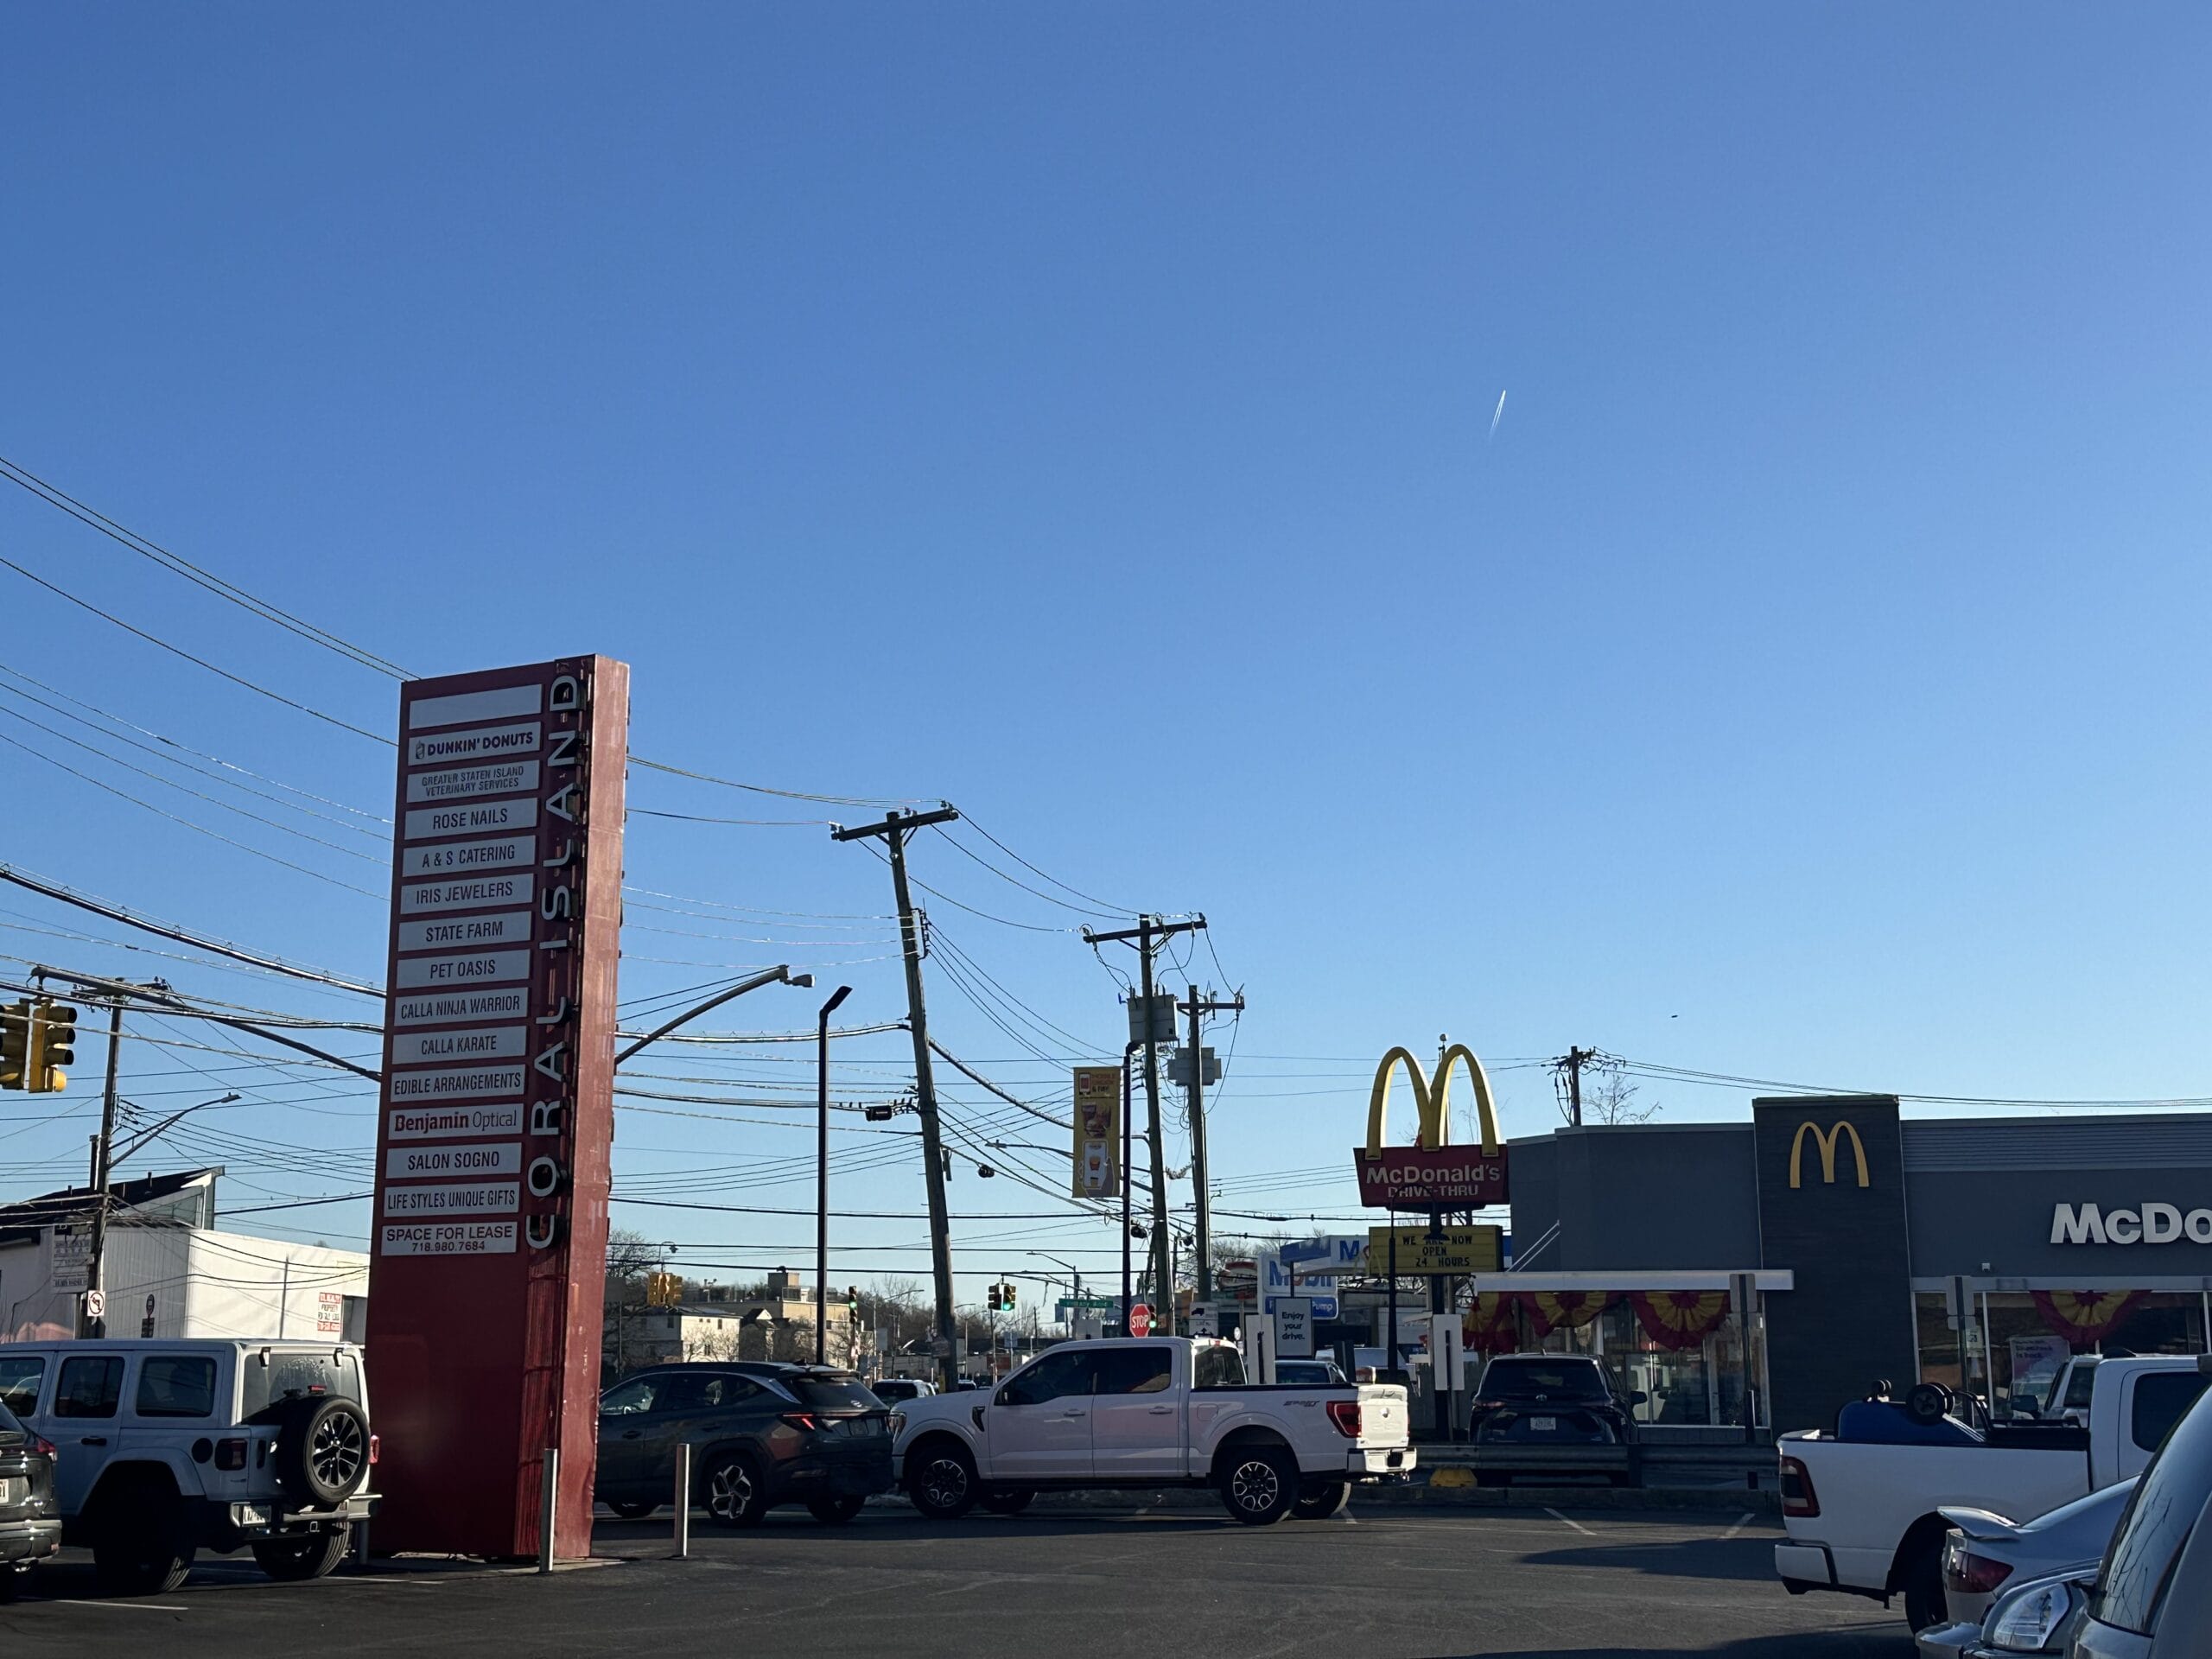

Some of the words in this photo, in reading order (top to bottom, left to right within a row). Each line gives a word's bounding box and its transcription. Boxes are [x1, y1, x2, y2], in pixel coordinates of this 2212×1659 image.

[427, 738, 480, 756] DUNKIN'
[482, 732, 533, 749] DONUTS
[422, 773, 459, 786] GREATER
[461, 768, 491, 782] STATEN
[493, 766, 524, 778] ISLAND
[426, 782, 476, 796] VETERINARY
[478, 778, 518, 791] SERVICES
[433, 813, 467, 830] ROSE
[471, 809, 508, 826] NAILS
[539, 674, 579, 950] ISLAND
[422, 853, 429, 868] A
[434, 851, 442, 866] &
[446, 850, 453, 865] S
[459, 844, 515, 864] CATERING
[416, 889, 441, 905] IRIS
[445, 881, 513, 902] JEWELERS
[426, 924, 463, 942] STATE
[467, 921, 503, 938] FARM
[429, 963, 452, 979] PET
[457, 960, 495, 976] OASIS
[401, 1002, 433, 1019] CALLA
[436, 999, 467, 1016] NINJA
[470, 995, 520, 1014] WARRIOR
[421, 1039, 454, 1055] CALLA
[457, 1035, 497, 1052] KARATE
[394, 1077, 430, 1095] EDIBLE
[434, 1072, 521, 1093] ARRANGEMENTS
[394, 1111, 469, 1134] Benjamin
[473, 1109, 517, 1131] Optical
[525, 996, 567, 1249] CORAL
[408, 1154, 449, 1170] SALON
[454, 1151, 499, 1168] SOGNO
[1366, 1164, 1501, 1185] McDonald's
[388, 1193, 407, 1210] LIFE
[410, 1191, 445, 1209] STYLES
[448, 1190, 485, 1208] UNIQUE
[487, 1189, 515, 1205] GIFTS
[1388, 1185, 1479, 1198] DRIVE-THRU
[386, 1227, 432, 1242] SPACE
[435, 1226, 464, 1240] FOR
[468, 1224, 512, 1239] LEASE
[2050, 1202, 2212, 1244] McDo
[1403, 1236, 1416, 1245] WE
[1452, 1236, 1472, 1245] NOW
[1422, 1246, 1446, 1255] OPEN
[1415, 1258, 1427, 1268] 24
[1438, 1257, 1470, 1267] HOURS
[1132, 1314, 1149, 1328] STOP
[1281, 1312, 1305, 1321] Enjoy
